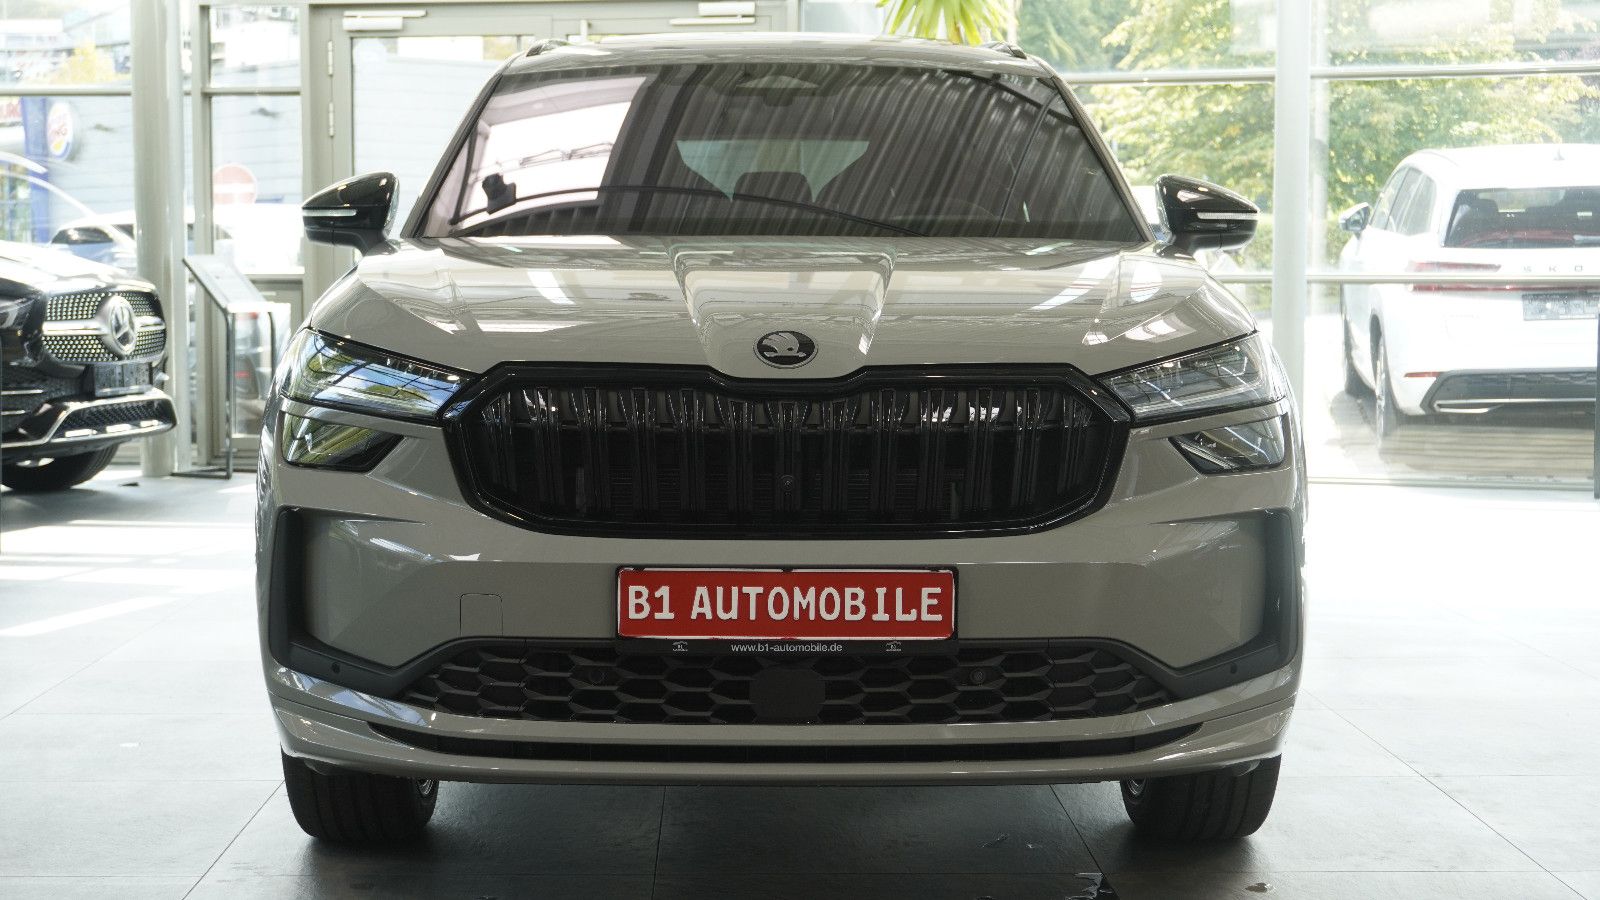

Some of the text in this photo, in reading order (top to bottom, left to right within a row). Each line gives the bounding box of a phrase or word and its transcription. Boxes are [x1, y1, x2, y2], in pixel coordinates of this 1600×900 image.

[628, 585, 943, 622] B1 AUTOMOBILE
[731, 642, 843, 653] www.b1-automobile.de
